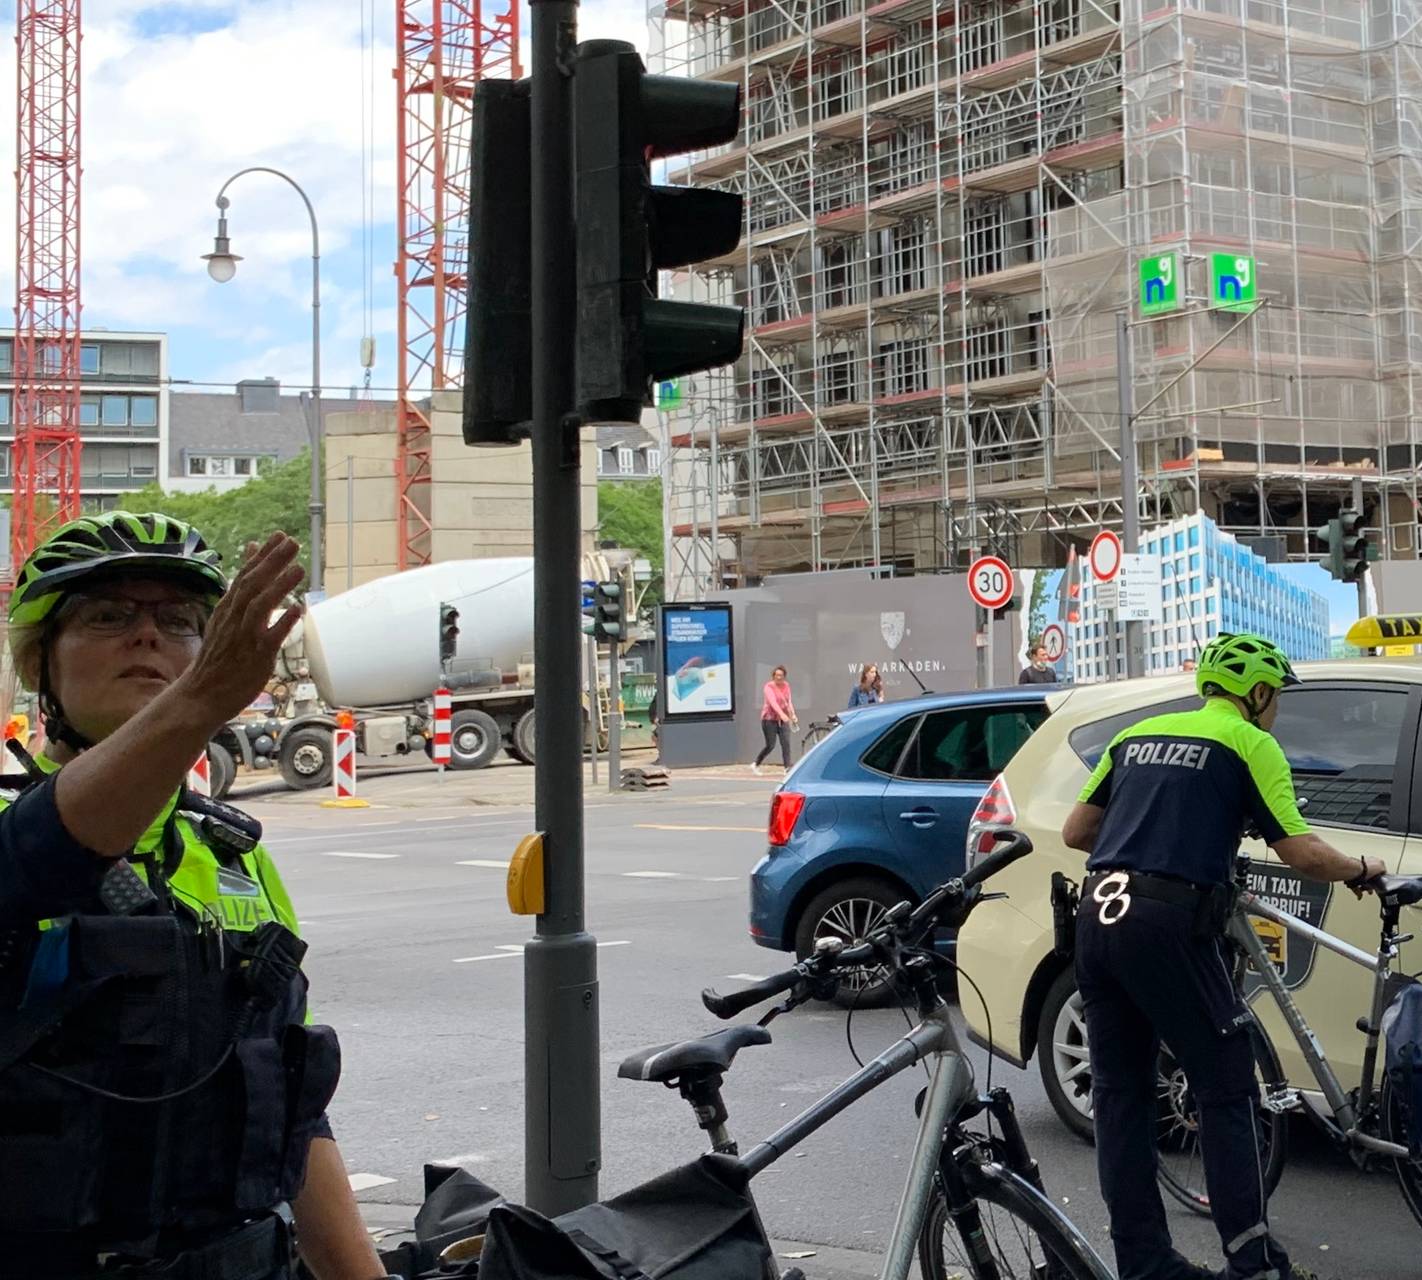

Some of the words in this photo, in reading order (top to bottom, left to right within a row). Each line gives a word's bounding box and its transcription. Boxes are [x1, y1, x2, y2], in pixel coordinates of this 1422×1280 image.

[978, 571, 1003, 593] 30
[1123, 743, 1211, 770] POLIZEI
[1271, 876, 1301, 896] TAXI
